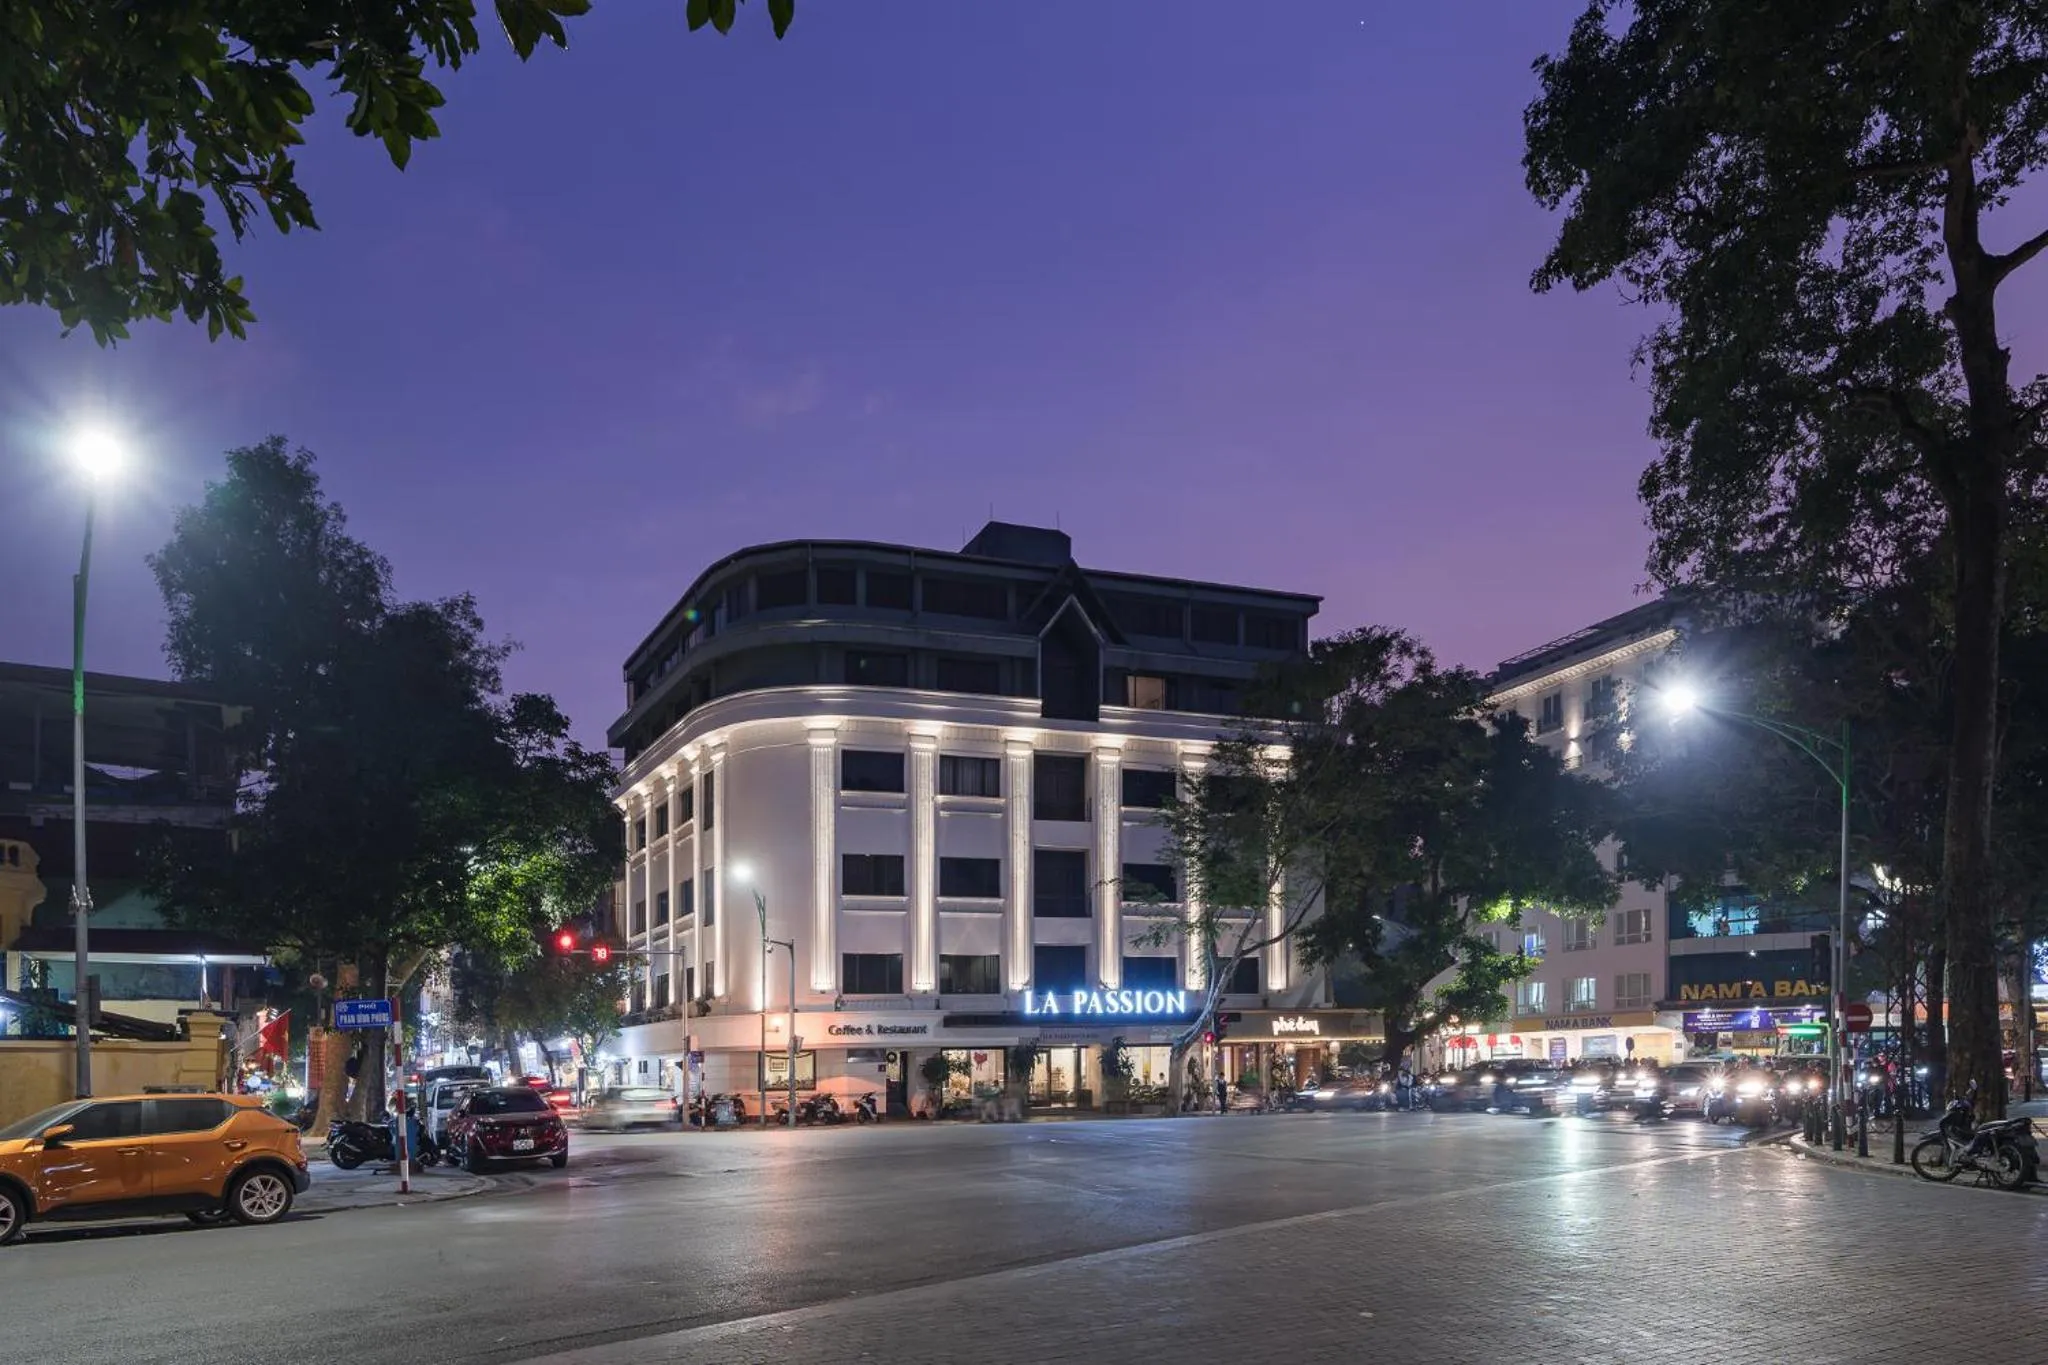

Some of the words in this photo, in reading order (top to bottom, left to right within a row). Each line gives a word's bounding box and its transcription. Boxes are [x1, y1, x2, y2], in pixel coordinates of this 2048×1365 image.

[1680, 983, 1742, 1000] NAM
[1750, 980, 1768, 998] A
[1024, 990, 1060, 1014] LA
[1073, 989, 1186, 1014] PASSION
[828, 1024, 863, 1036] Coffee
[865, 1025, 873, 1035] &
[877, 1024, 929, 1035] Restaurant
[1545, 1018, 1570, 1031] NAM
[1572, 1018, 1580, 1029] A
[1581, 1016, 1613, 1028] BANK
